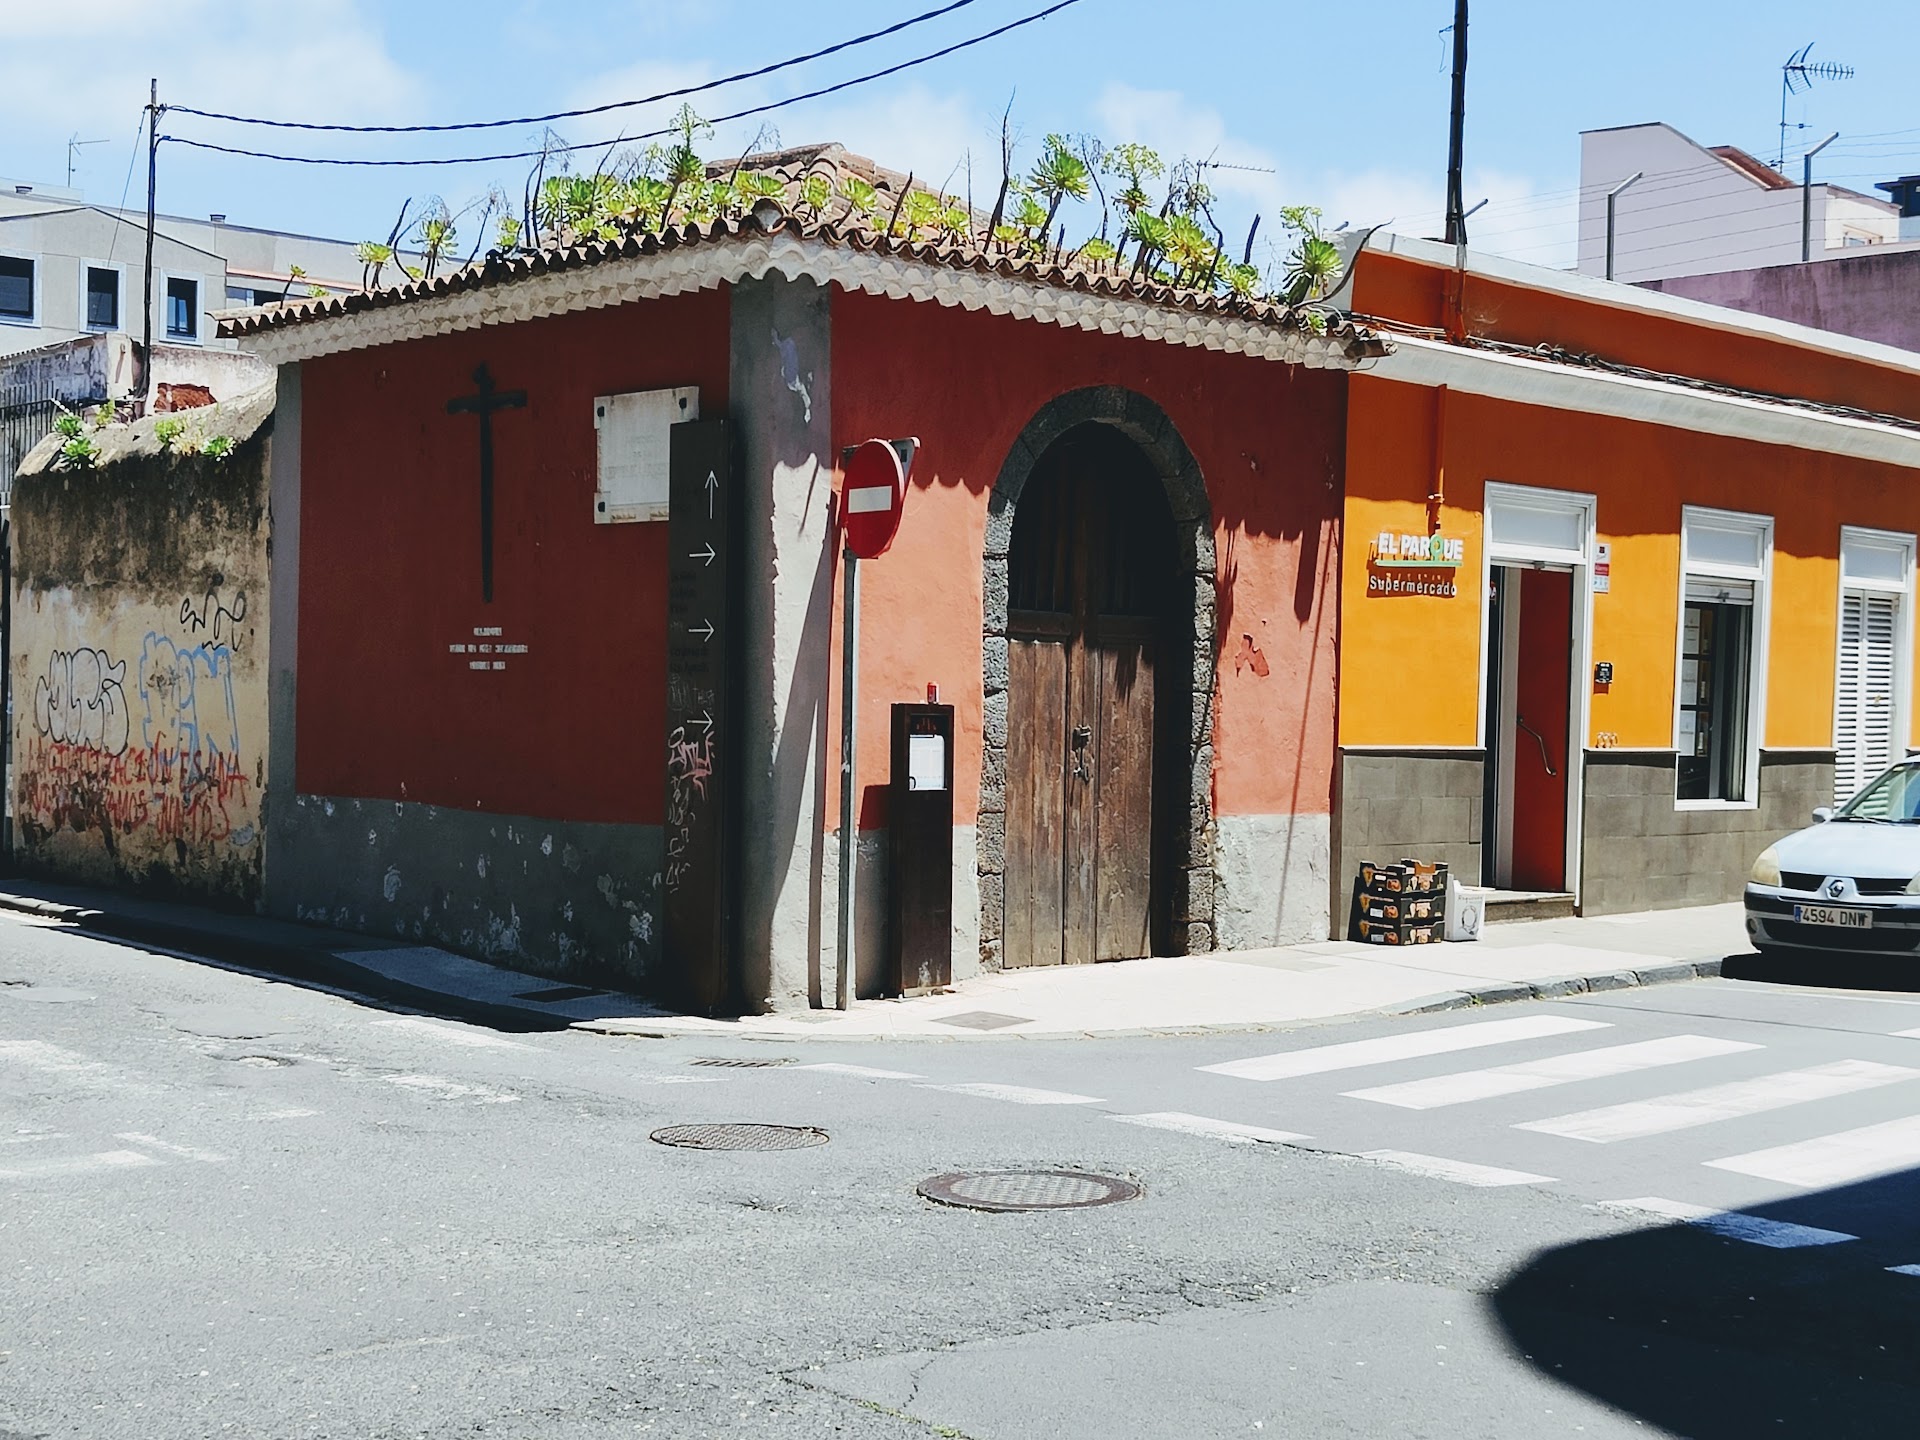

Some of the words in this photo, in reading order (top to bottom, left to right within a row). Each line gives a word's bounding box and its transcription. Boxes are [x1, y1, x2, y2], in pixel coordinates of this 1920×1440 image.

[1378, 532, 1398, 554] EL
[1400, 533, 1463, 561] PARQUE
[1369, 575, 1457, 596] Supermercado
[1802, 907, 1835, 924] 4594
